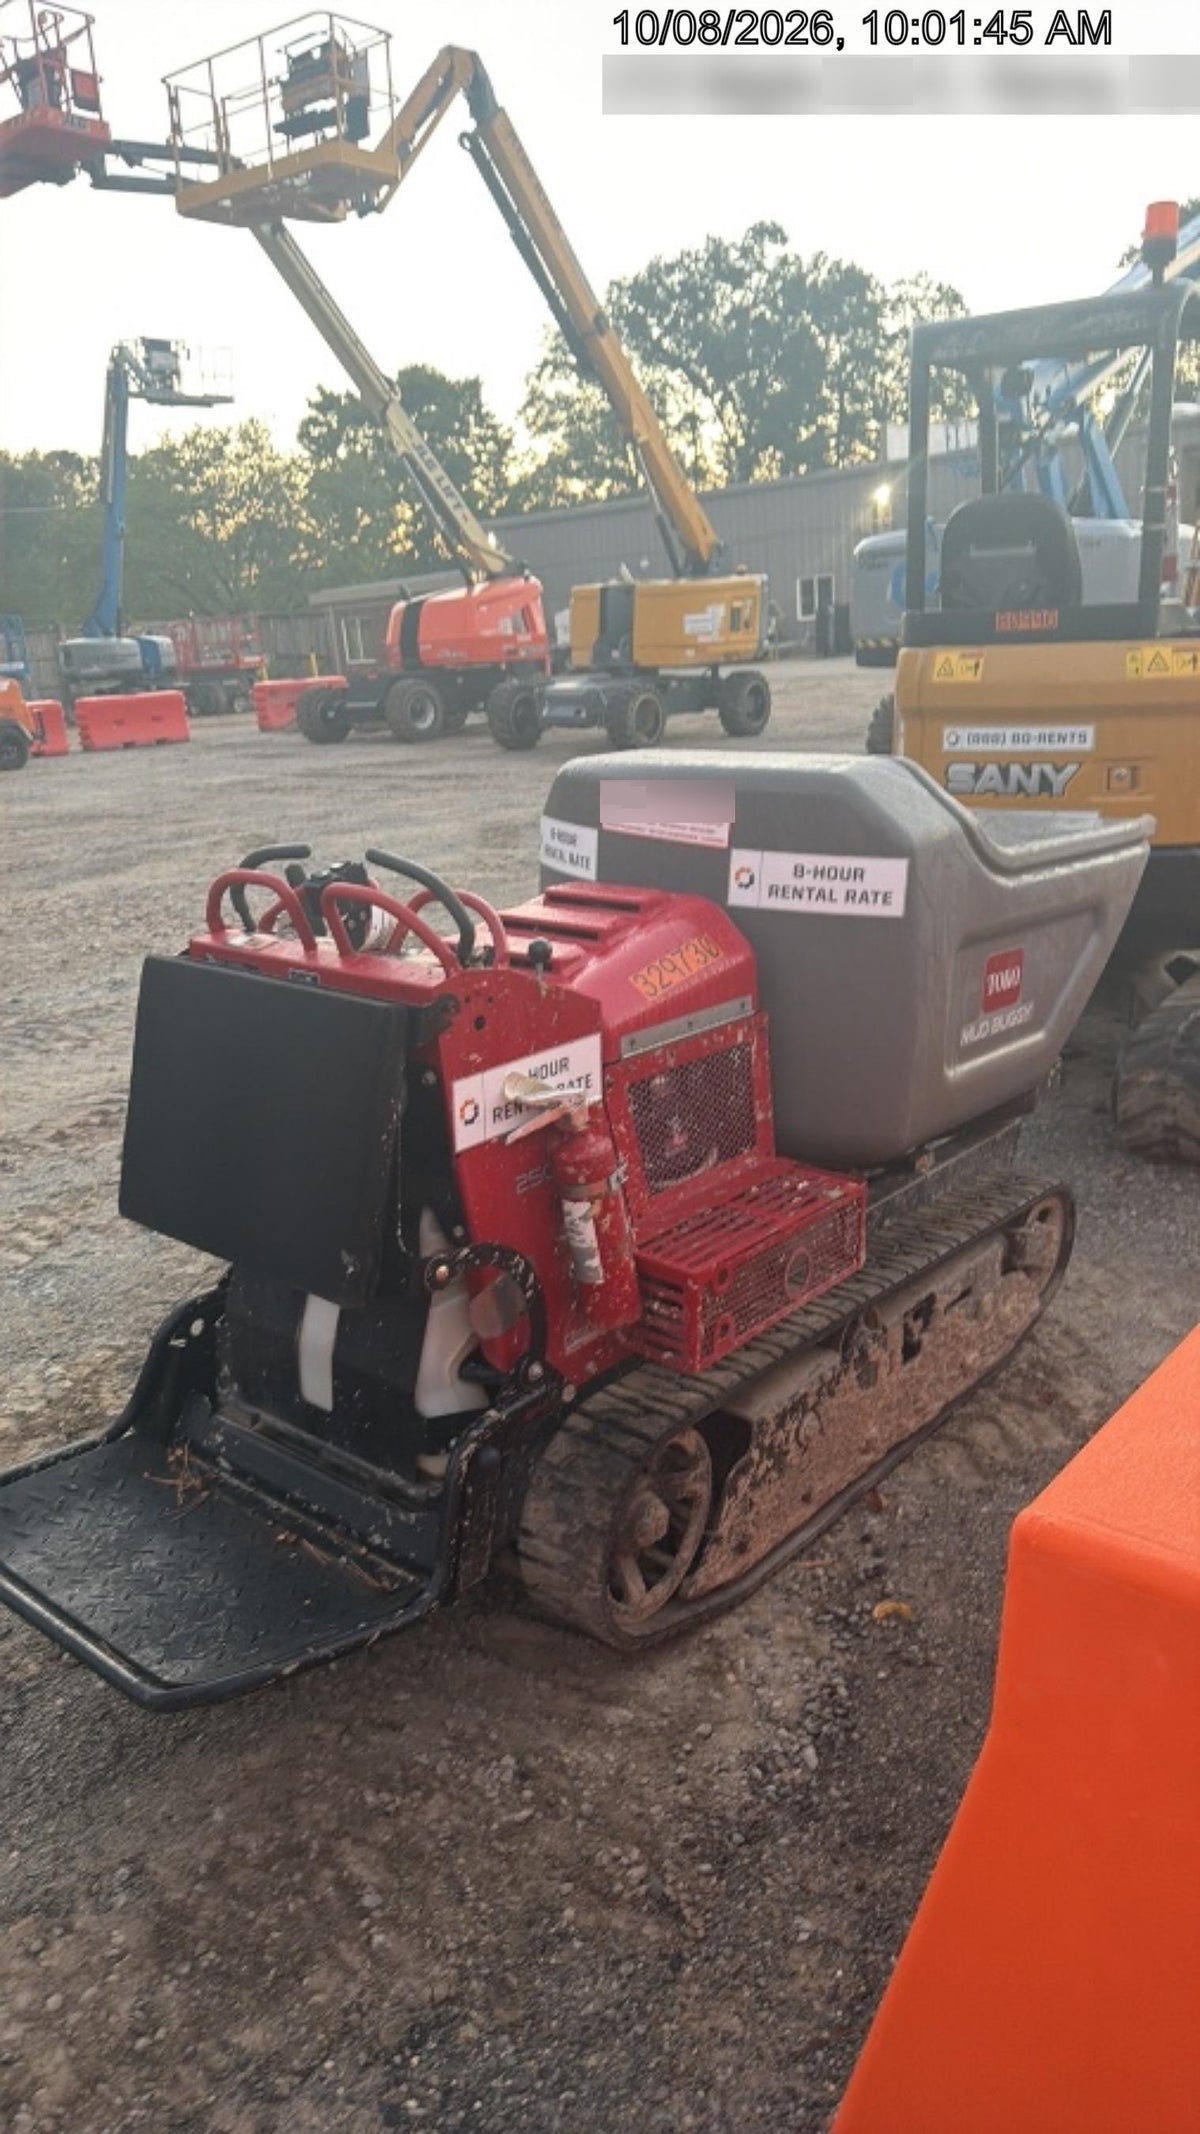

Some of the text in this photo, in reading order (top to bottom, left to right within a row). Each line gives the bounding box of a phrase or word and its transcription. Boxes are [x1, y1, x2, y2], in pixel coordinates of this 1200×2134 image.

[946, 761, 1083, 797] SANY
[768, 883, 893, 907] RENTAL RATE
[960, 1019, 990, 1049] MUD
